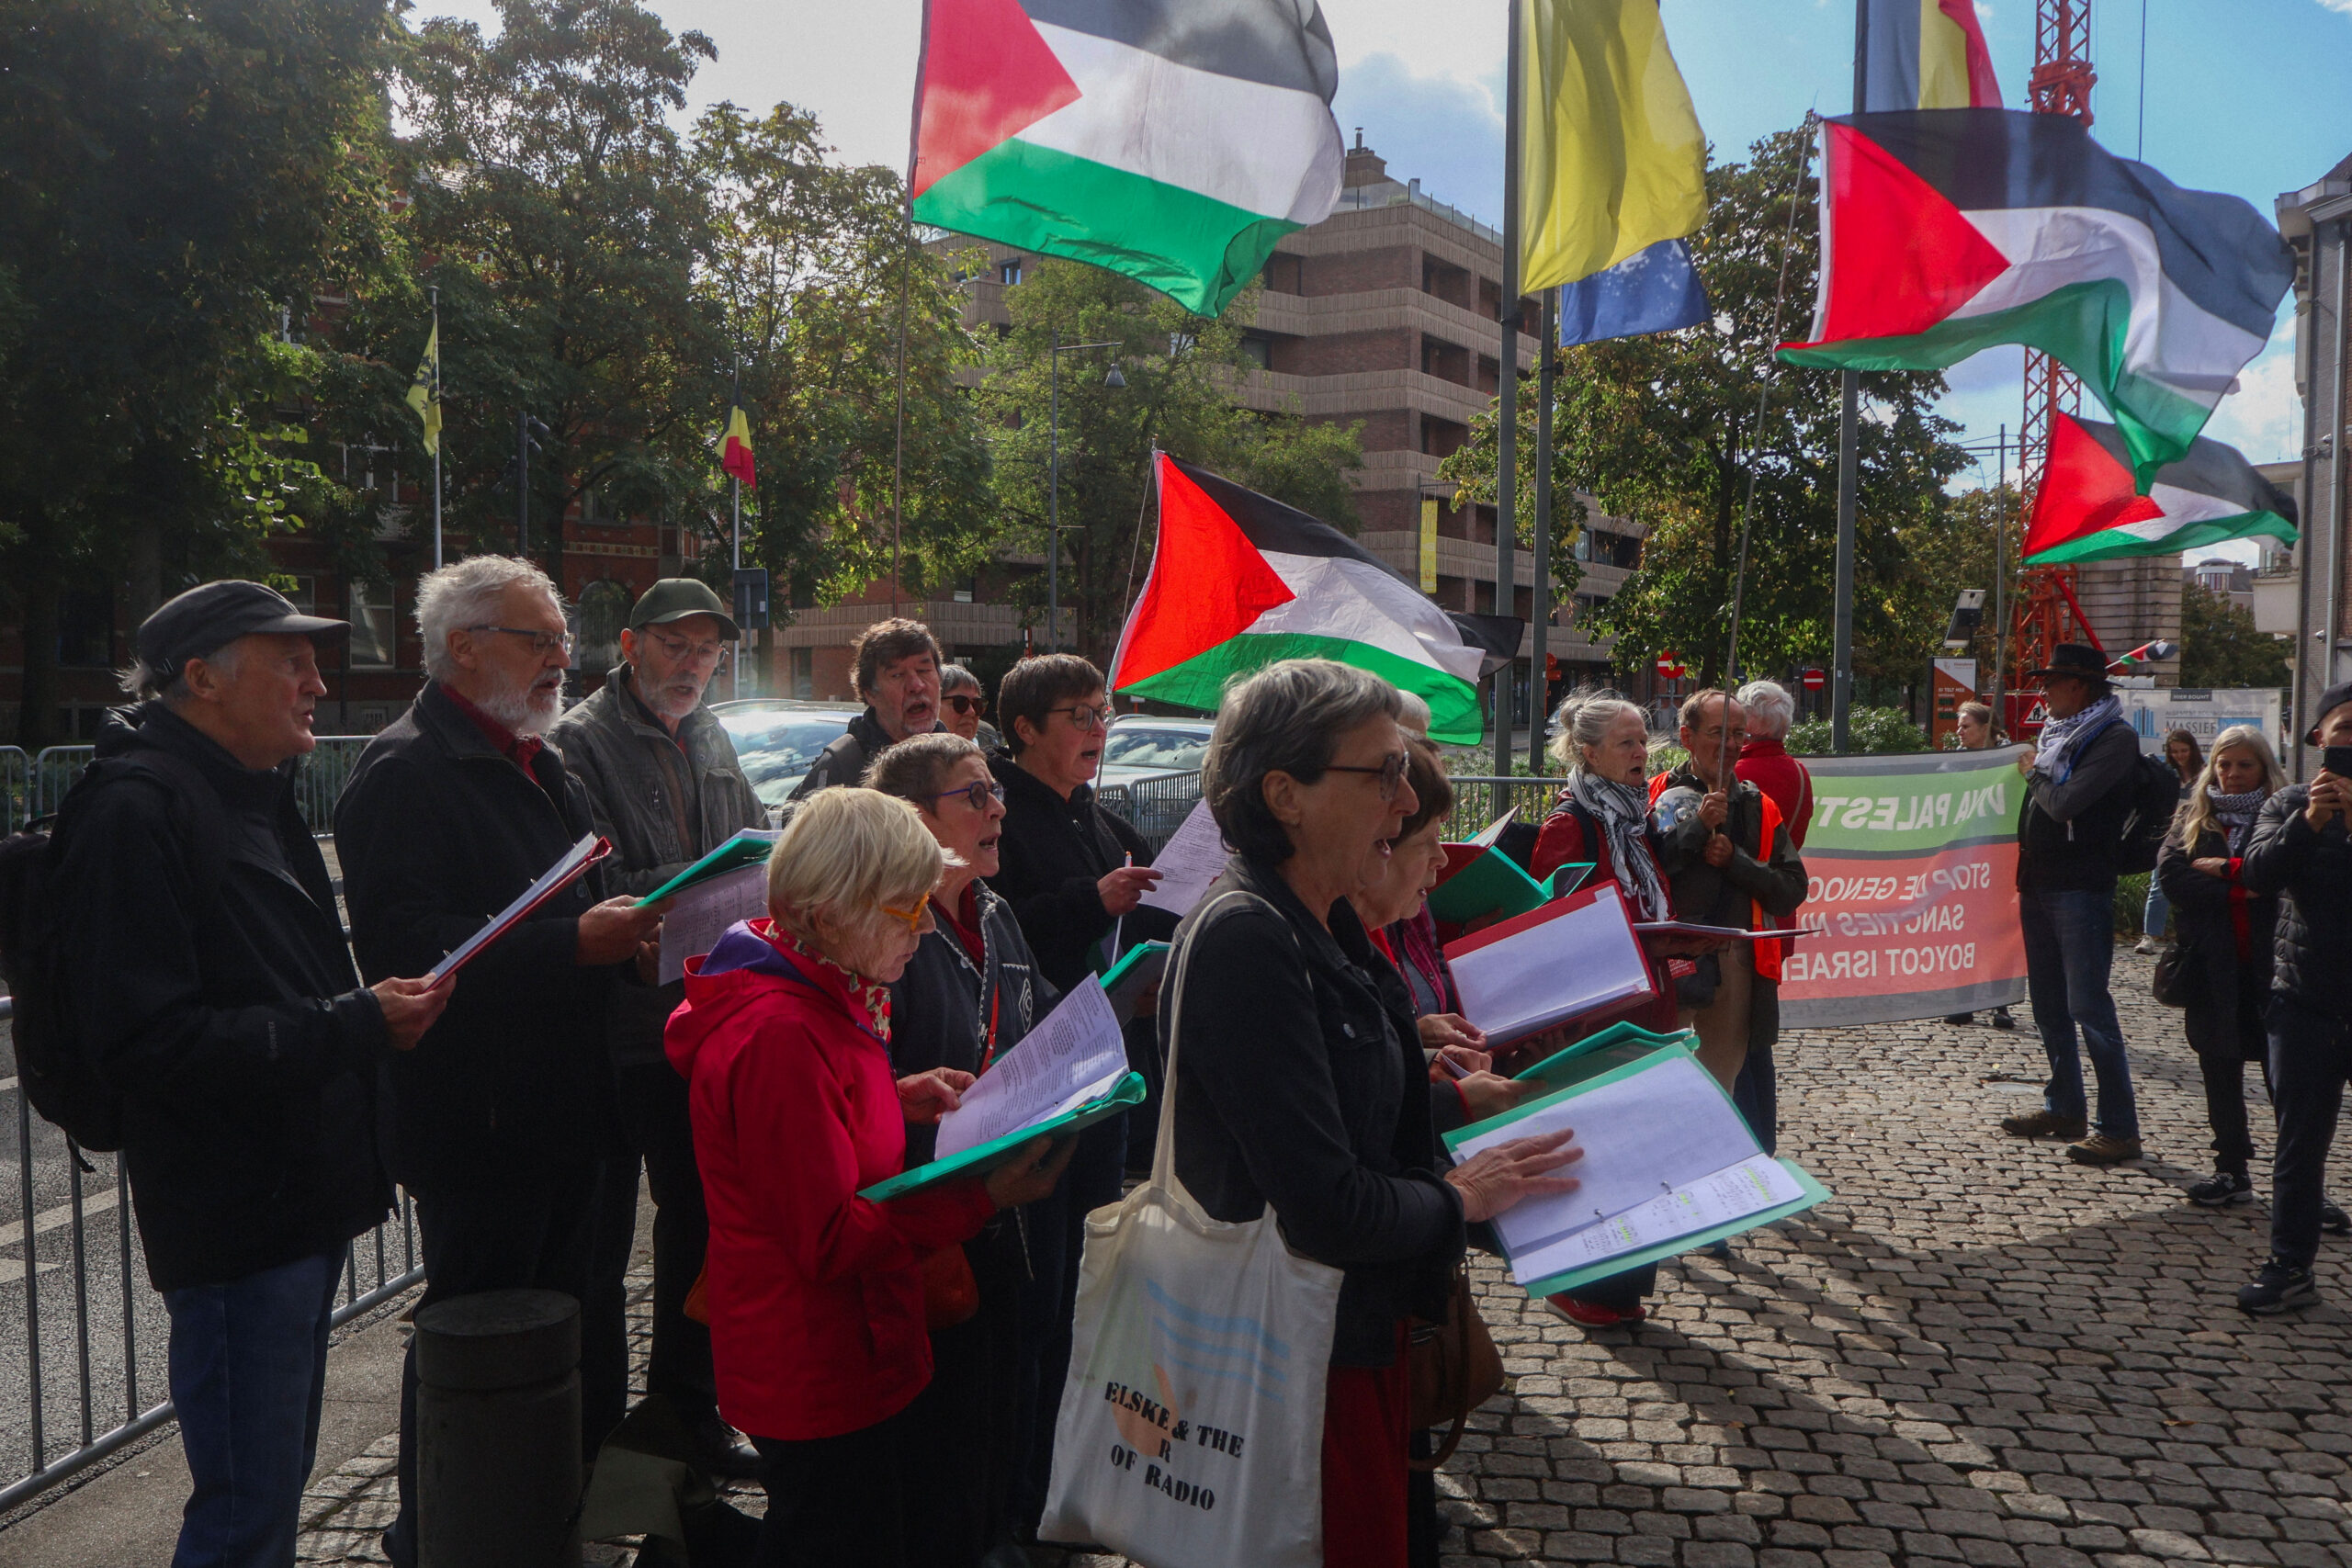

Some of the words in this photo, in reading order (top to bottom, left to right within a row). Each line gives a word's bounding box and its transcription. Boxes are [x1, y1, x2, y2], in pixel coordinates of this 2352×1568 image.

[1104, 1382, 1170, 1431] ELSKE
[1171, 1419, 1189, 1442] &
[1197, 1425, 1244, 1459] THE
[1159, 1438, 1171, 1463] R
[1110, 1444, 1138, 1472] OF
[1144, 1463, 1216, 1511] RADIO
